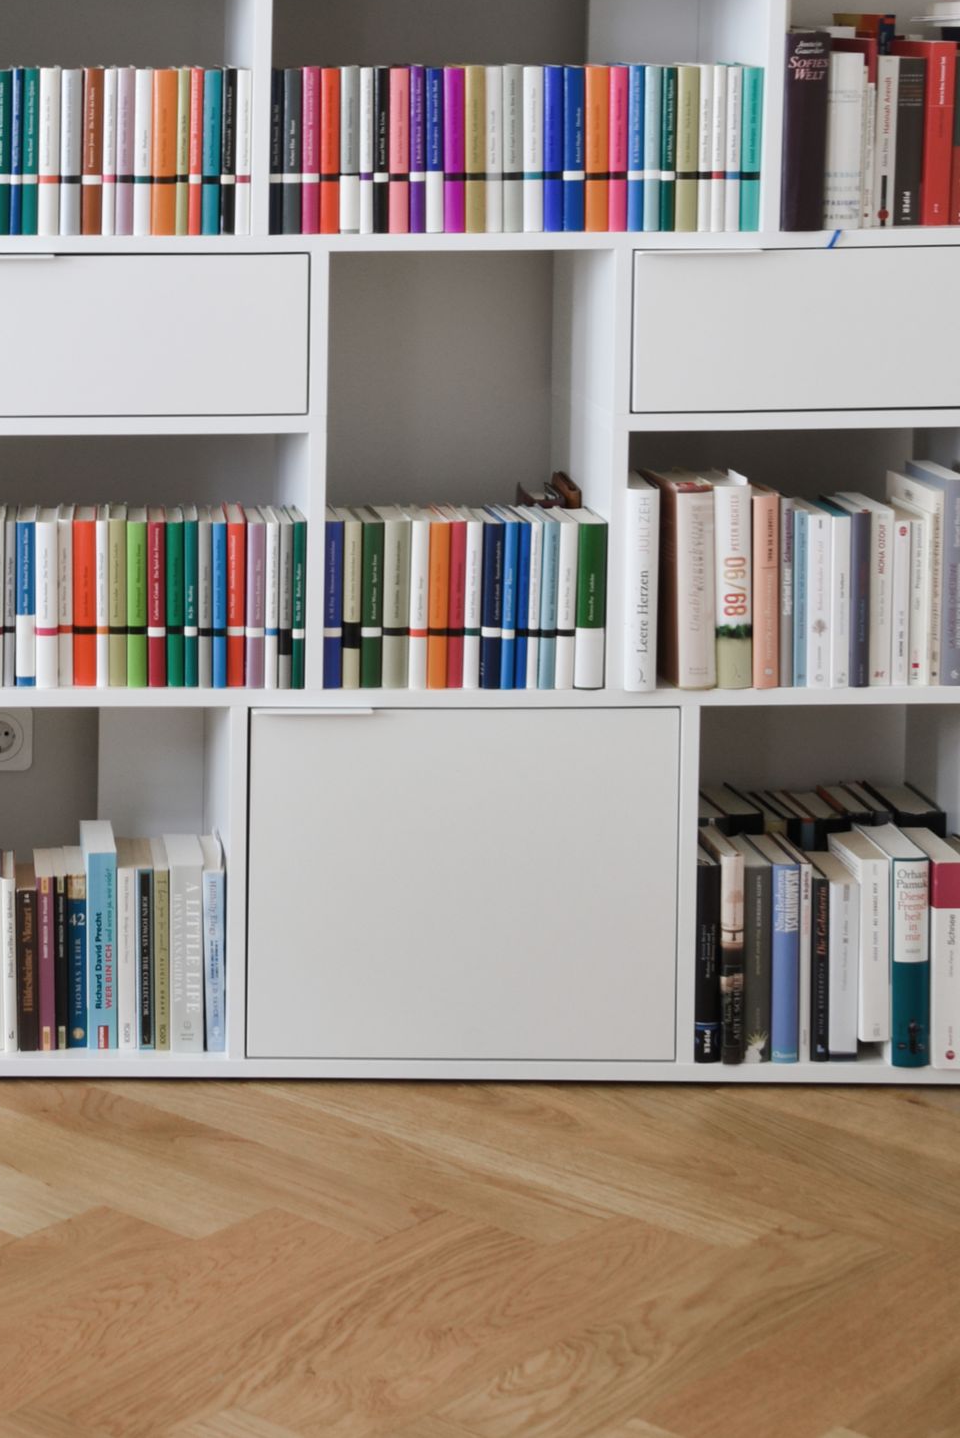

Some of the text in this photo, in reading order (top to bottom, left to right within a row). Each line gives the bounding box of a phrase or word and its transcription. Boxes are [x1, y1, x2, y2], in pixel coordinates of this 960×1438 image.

[788, 56, 828, 68] SOFIES
[795, 69, 825, 80] WELT
[902, 191, 911, 213] PIPER
[730, 495, 740, 551] PETER RICHTER
[636, 497, 650, 653] Leere Herzen JULI ZEH
[724, 557, 747, 616] 89/90
[775, 870, 785, 932] Nina Berberova
[897, 869, 927, 878] Orhan
[69, 913, 86, 926] 42
[174, 893, 182, 1002] HANYA YANAGIHARA
[22, 908, 33, 1012] Hildesheimer Mozart
[186, 882, 200, 1014] A LITTLE LIFE
[703, 1030, 711, 1053] PIPER
